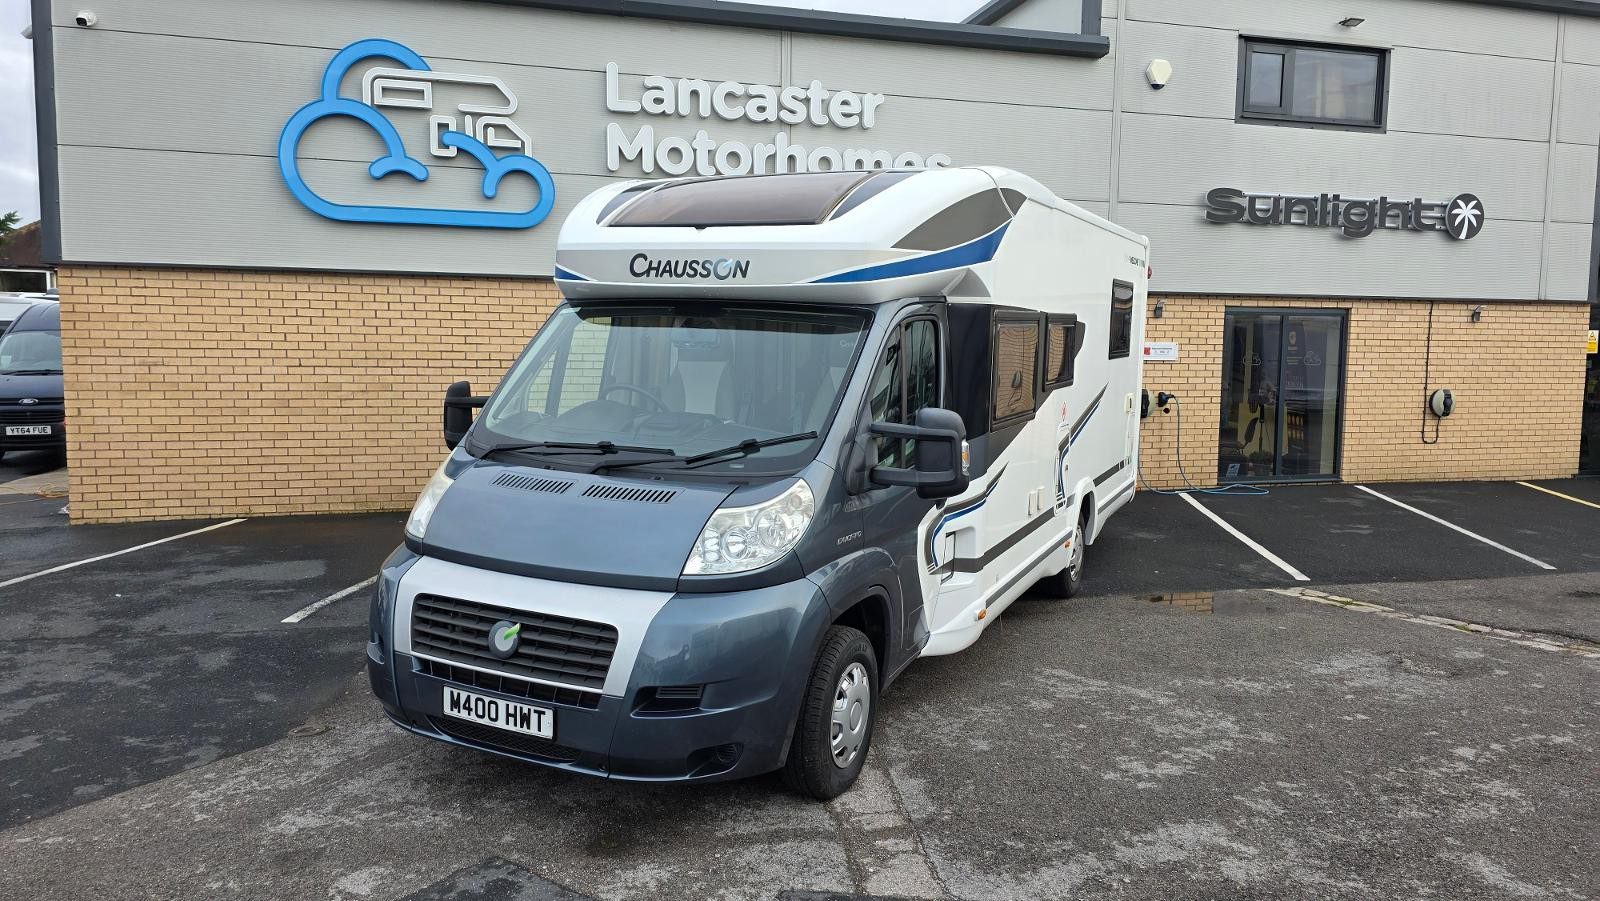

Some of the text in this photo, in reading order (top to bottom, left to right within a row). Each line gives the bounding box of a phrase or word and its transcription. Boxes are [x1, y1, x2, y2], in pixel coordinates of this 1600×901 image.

[606, 62, 885, 129] Lancaster
[1205, 187, 1437, 238] Sunlight
[629, 252, 750, 280] CHAUSSON
[32, 426, 48, 434] FUE
[449, 690, 546, 732] M400 HWT
